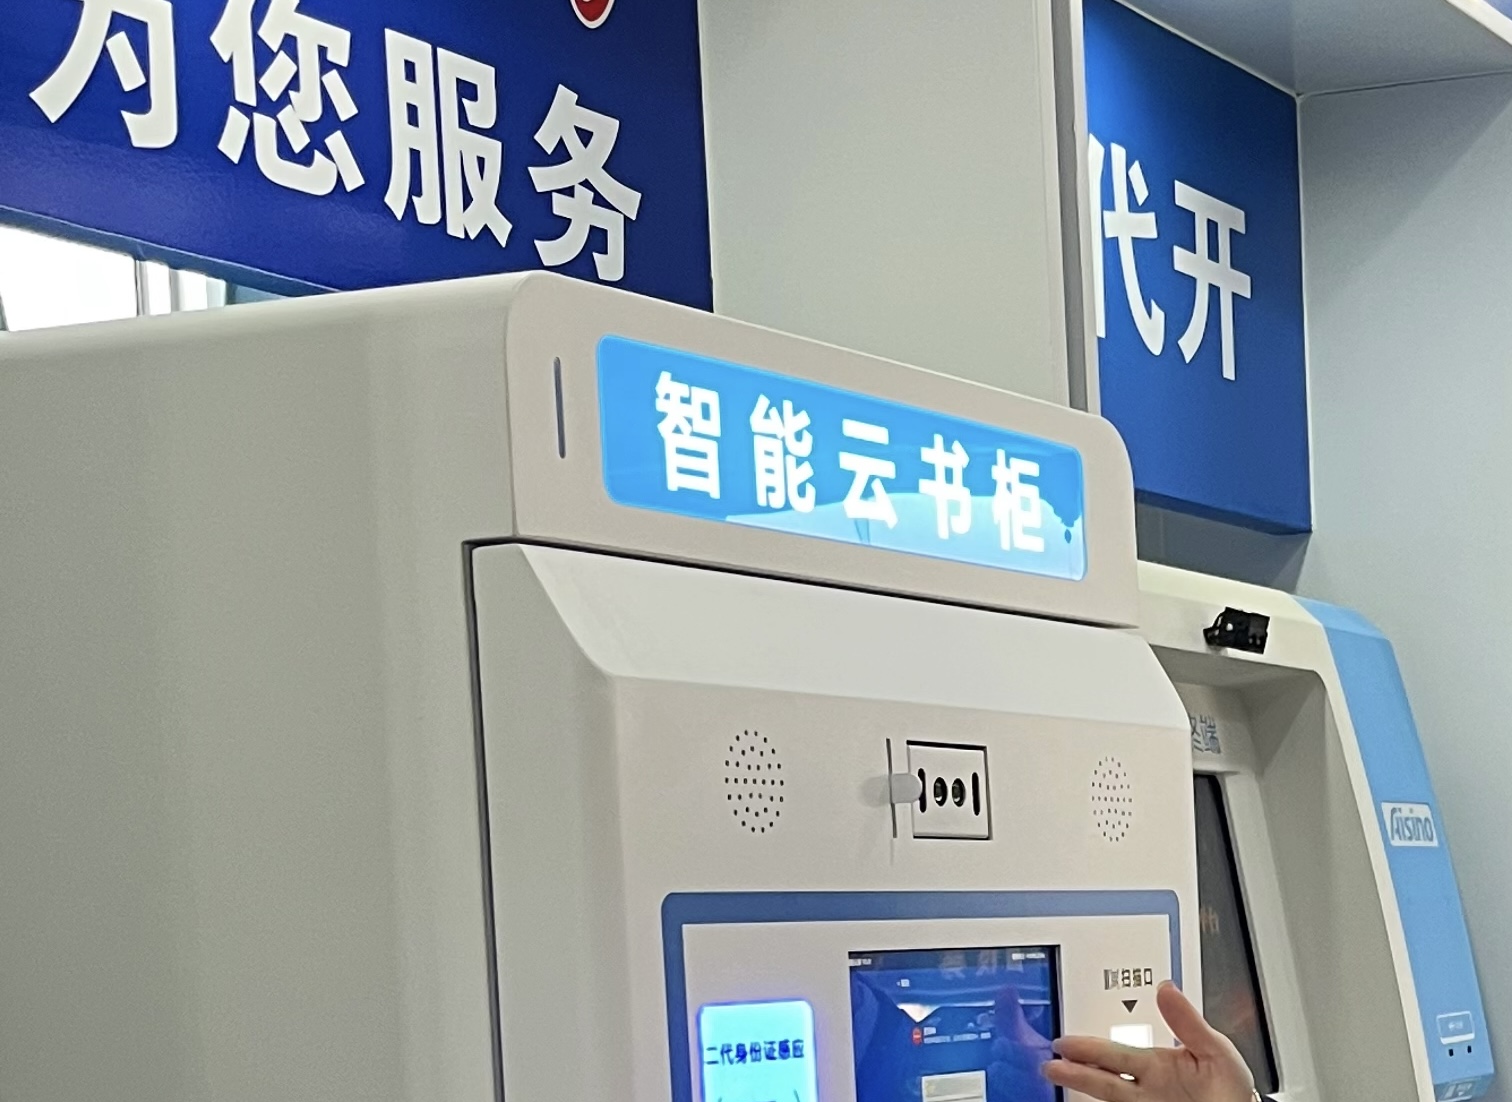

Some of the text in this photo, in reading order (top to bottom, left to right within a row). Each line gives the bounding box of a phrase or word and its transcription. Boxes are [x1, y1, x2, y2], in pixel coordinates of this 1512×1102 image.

[29, 0, 642, 282] 为您服务
[1088, 132, 1252, 381] 代开
[655, 371, 1046, 555] 智能云书柜
